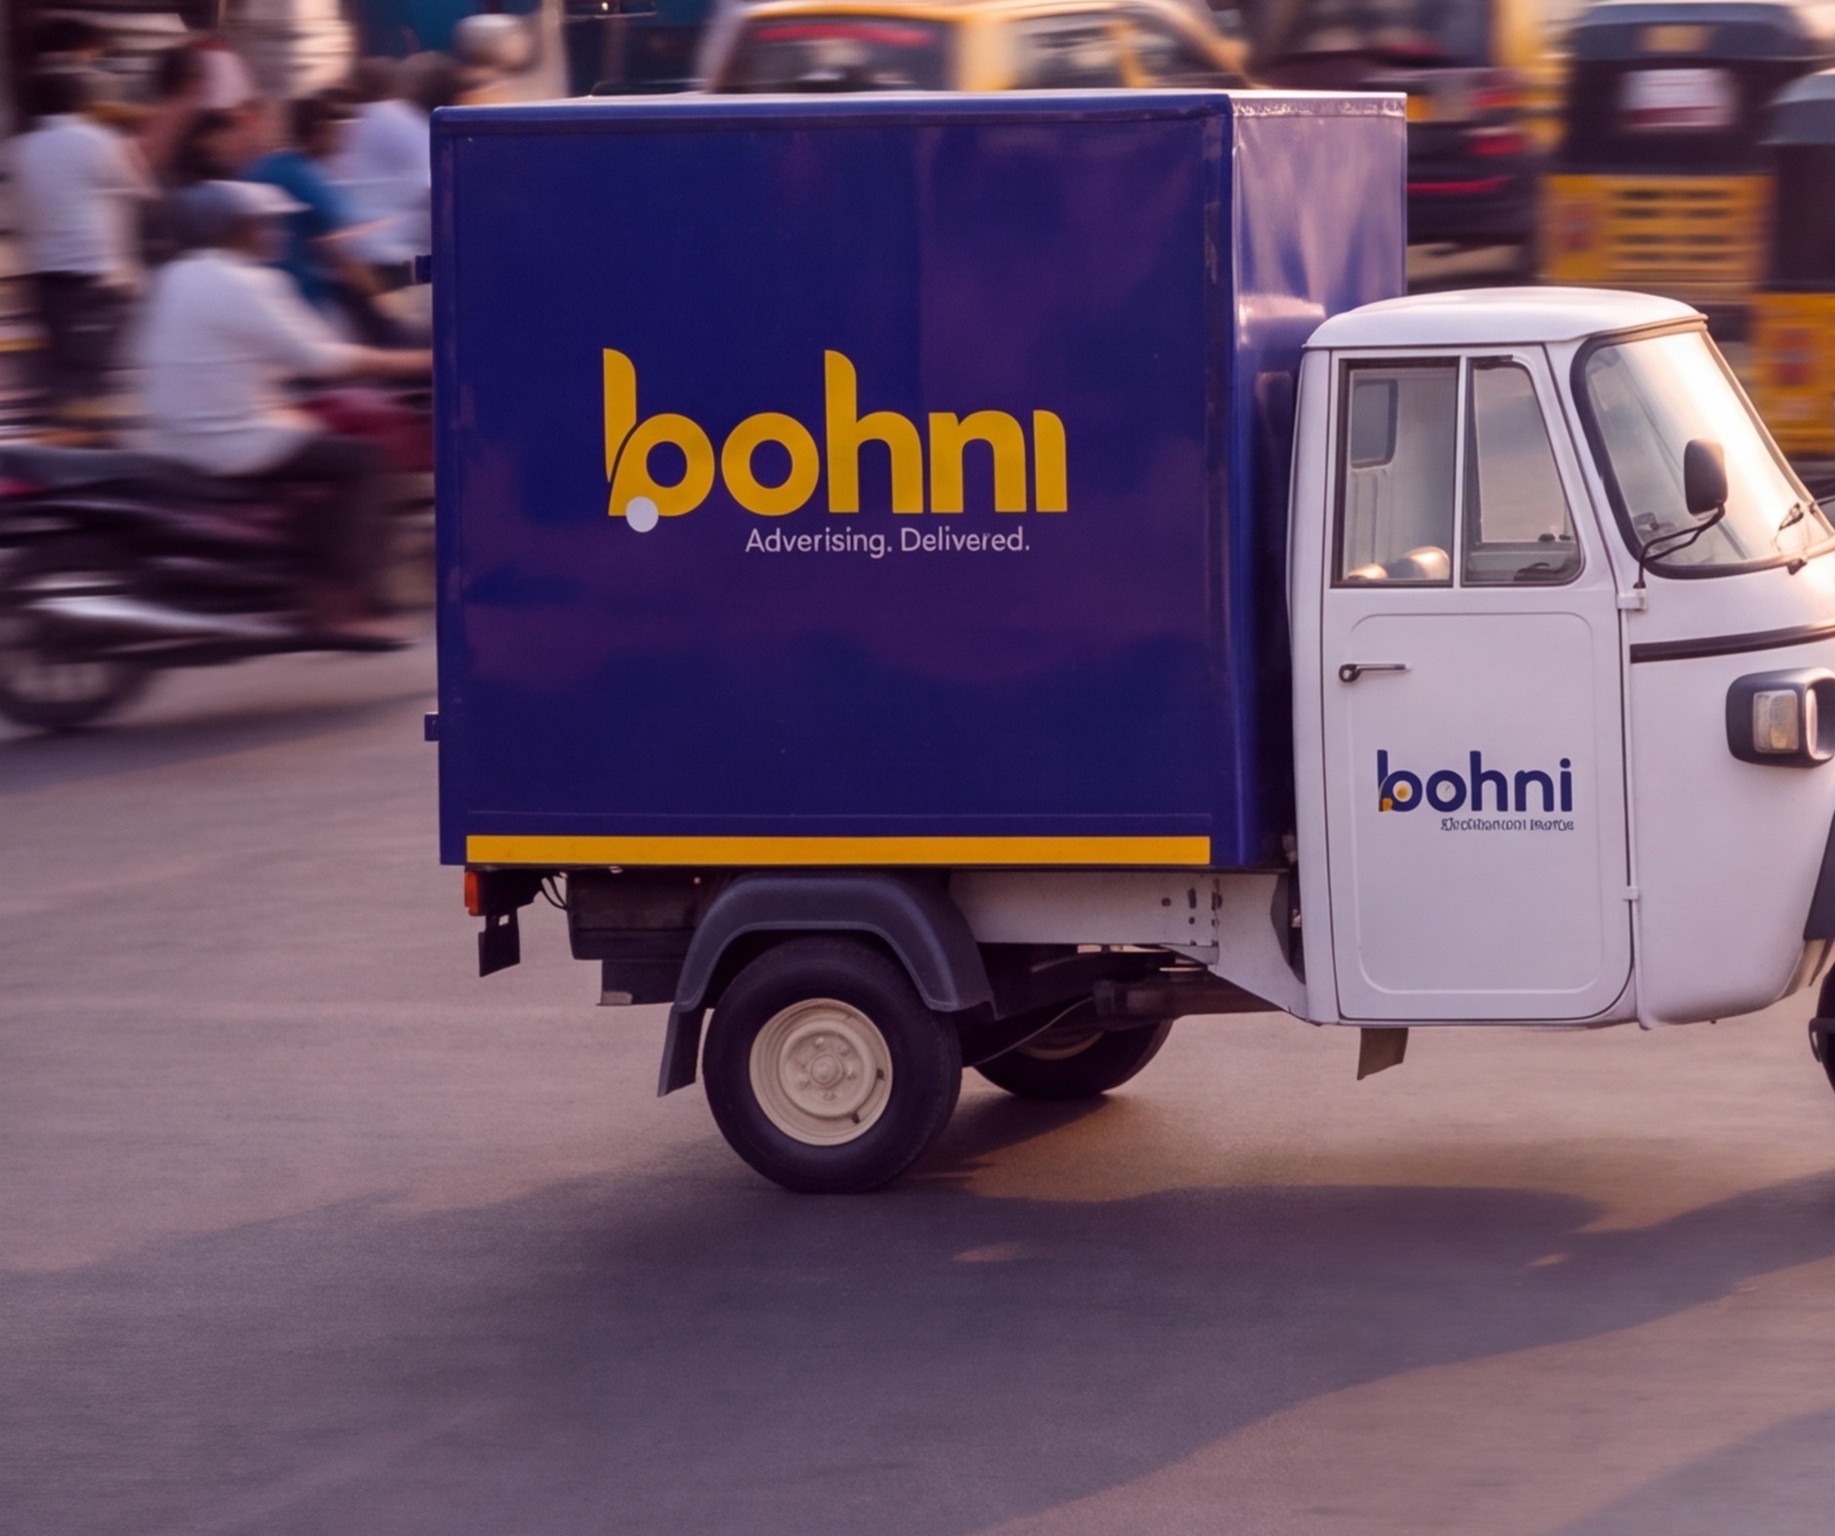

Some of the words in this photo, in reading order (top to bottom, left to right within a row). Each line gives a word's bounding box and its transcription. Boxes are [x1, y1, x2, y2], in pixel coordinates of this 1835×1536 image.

[745, 527, 893, 559] Adverising.
[900, 526, 1031, 552] Delivered.
[1377, 749, 1573, 812] bohni
